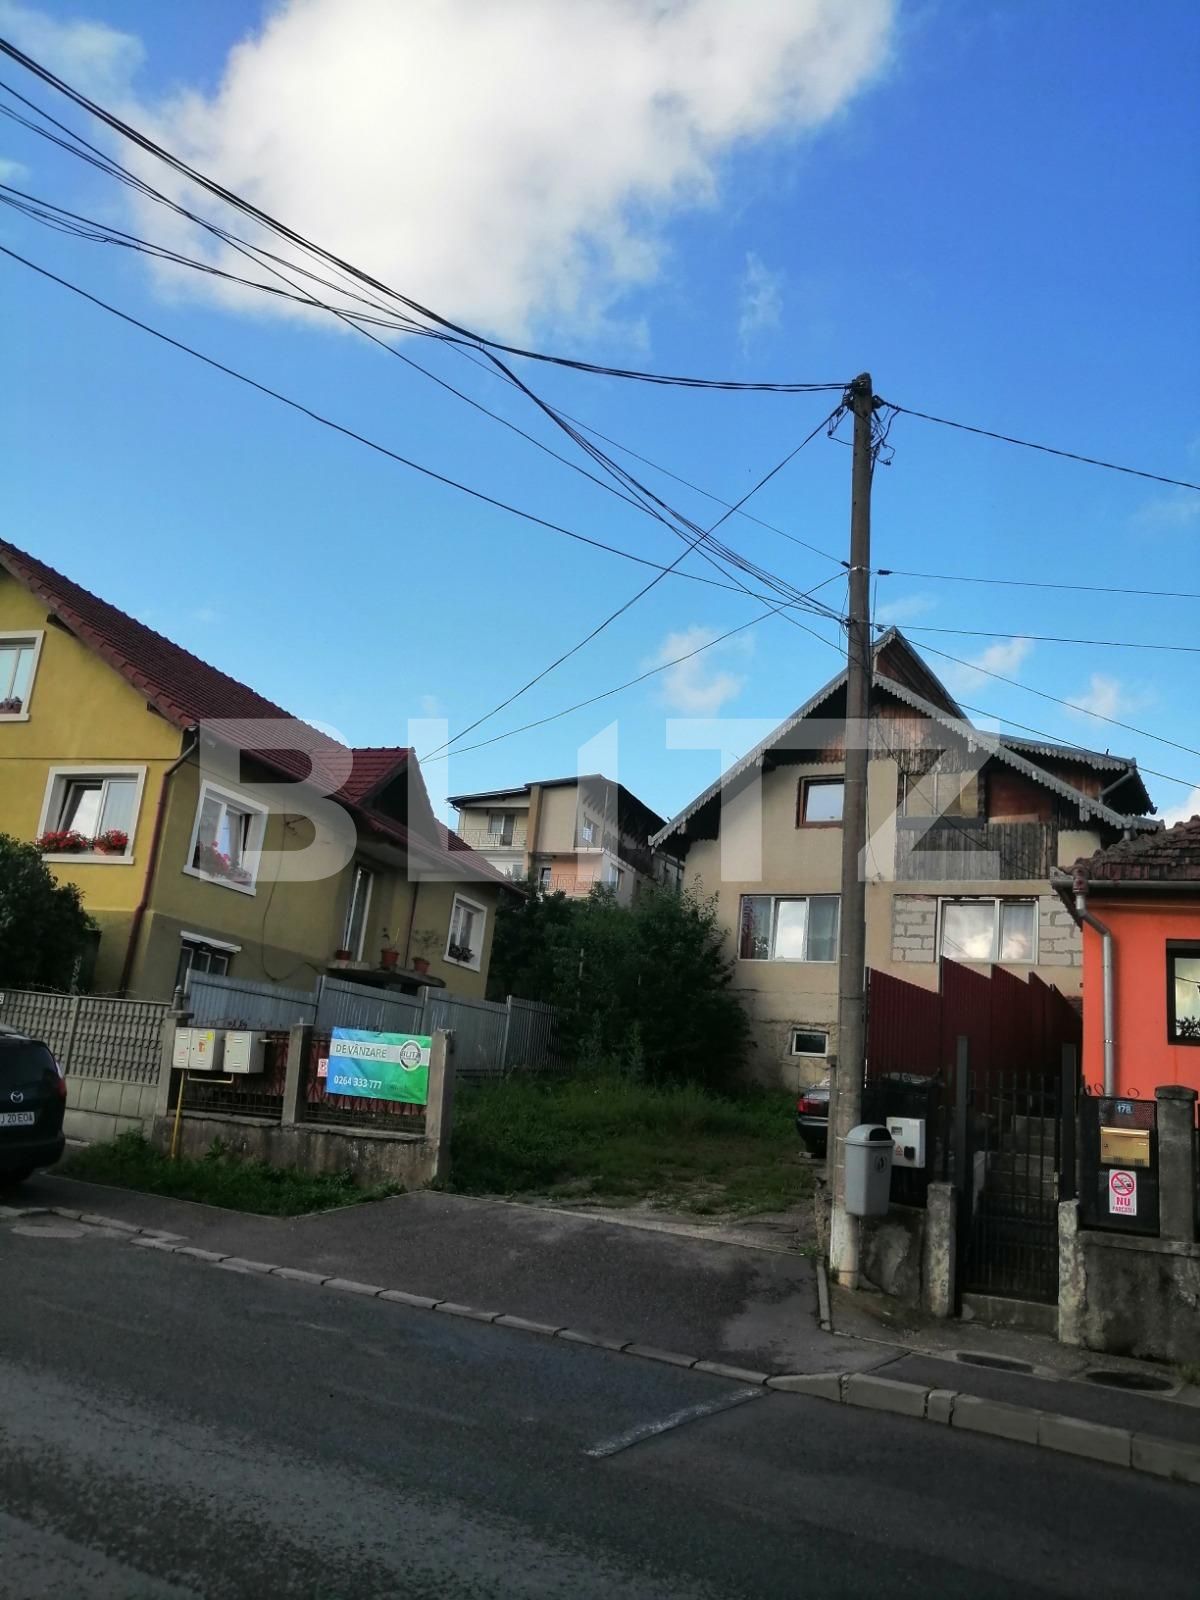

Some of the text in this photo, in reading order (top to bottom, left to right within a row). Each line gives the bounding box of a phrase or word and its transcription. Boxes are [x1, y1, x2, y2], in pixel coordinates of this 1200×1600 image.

[334, 1075, 352, 1086] 0264
[353, 1077, 368, 1088] 333
[1116, 1197, 1131, 1206] NU
